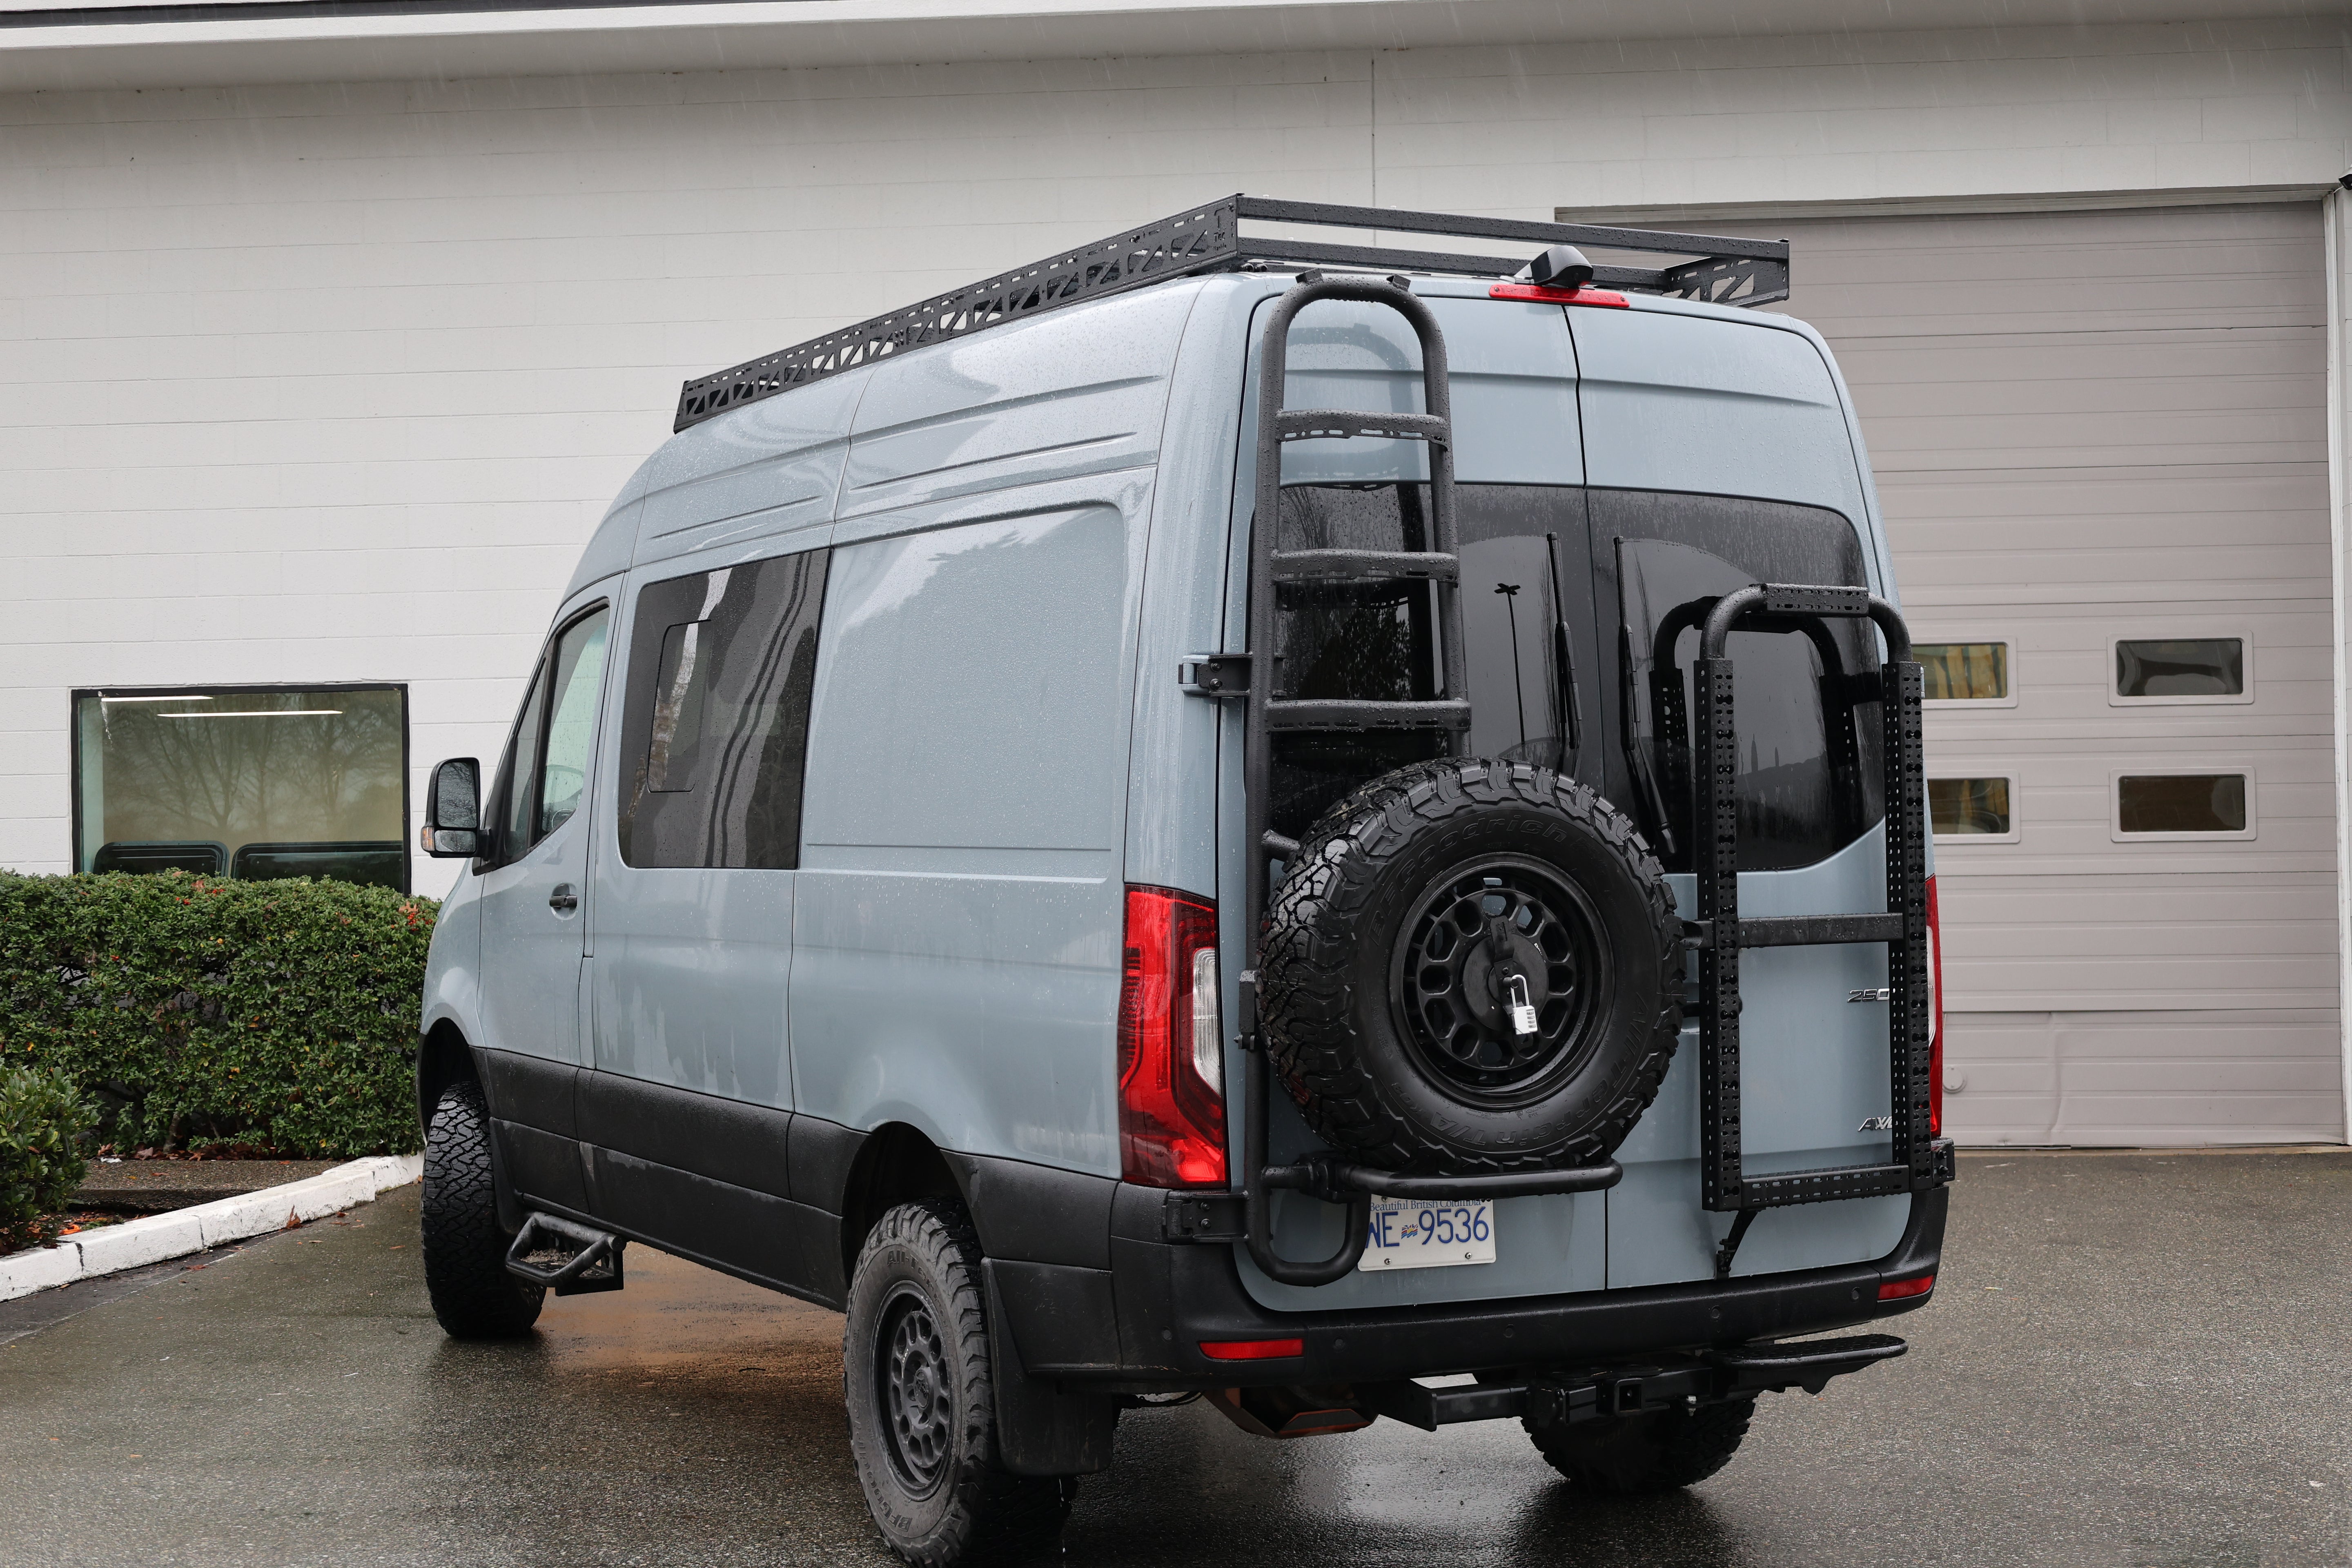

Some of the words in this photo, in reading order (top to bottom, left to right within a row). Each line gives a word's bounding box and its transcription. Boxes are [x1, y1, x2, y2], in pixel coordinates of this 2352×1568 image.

[1368, 815, 1567, 946] BFGoodrich
[1847, 988, 1890, 1003] 250
[1430, 1111, 1486, 1146] T/A
[1370, 1200, 1408, 1212] Beautiful
[1410, 1200, 1438, 1209] British
[1418, 1206, 1489, 1245] 9536
